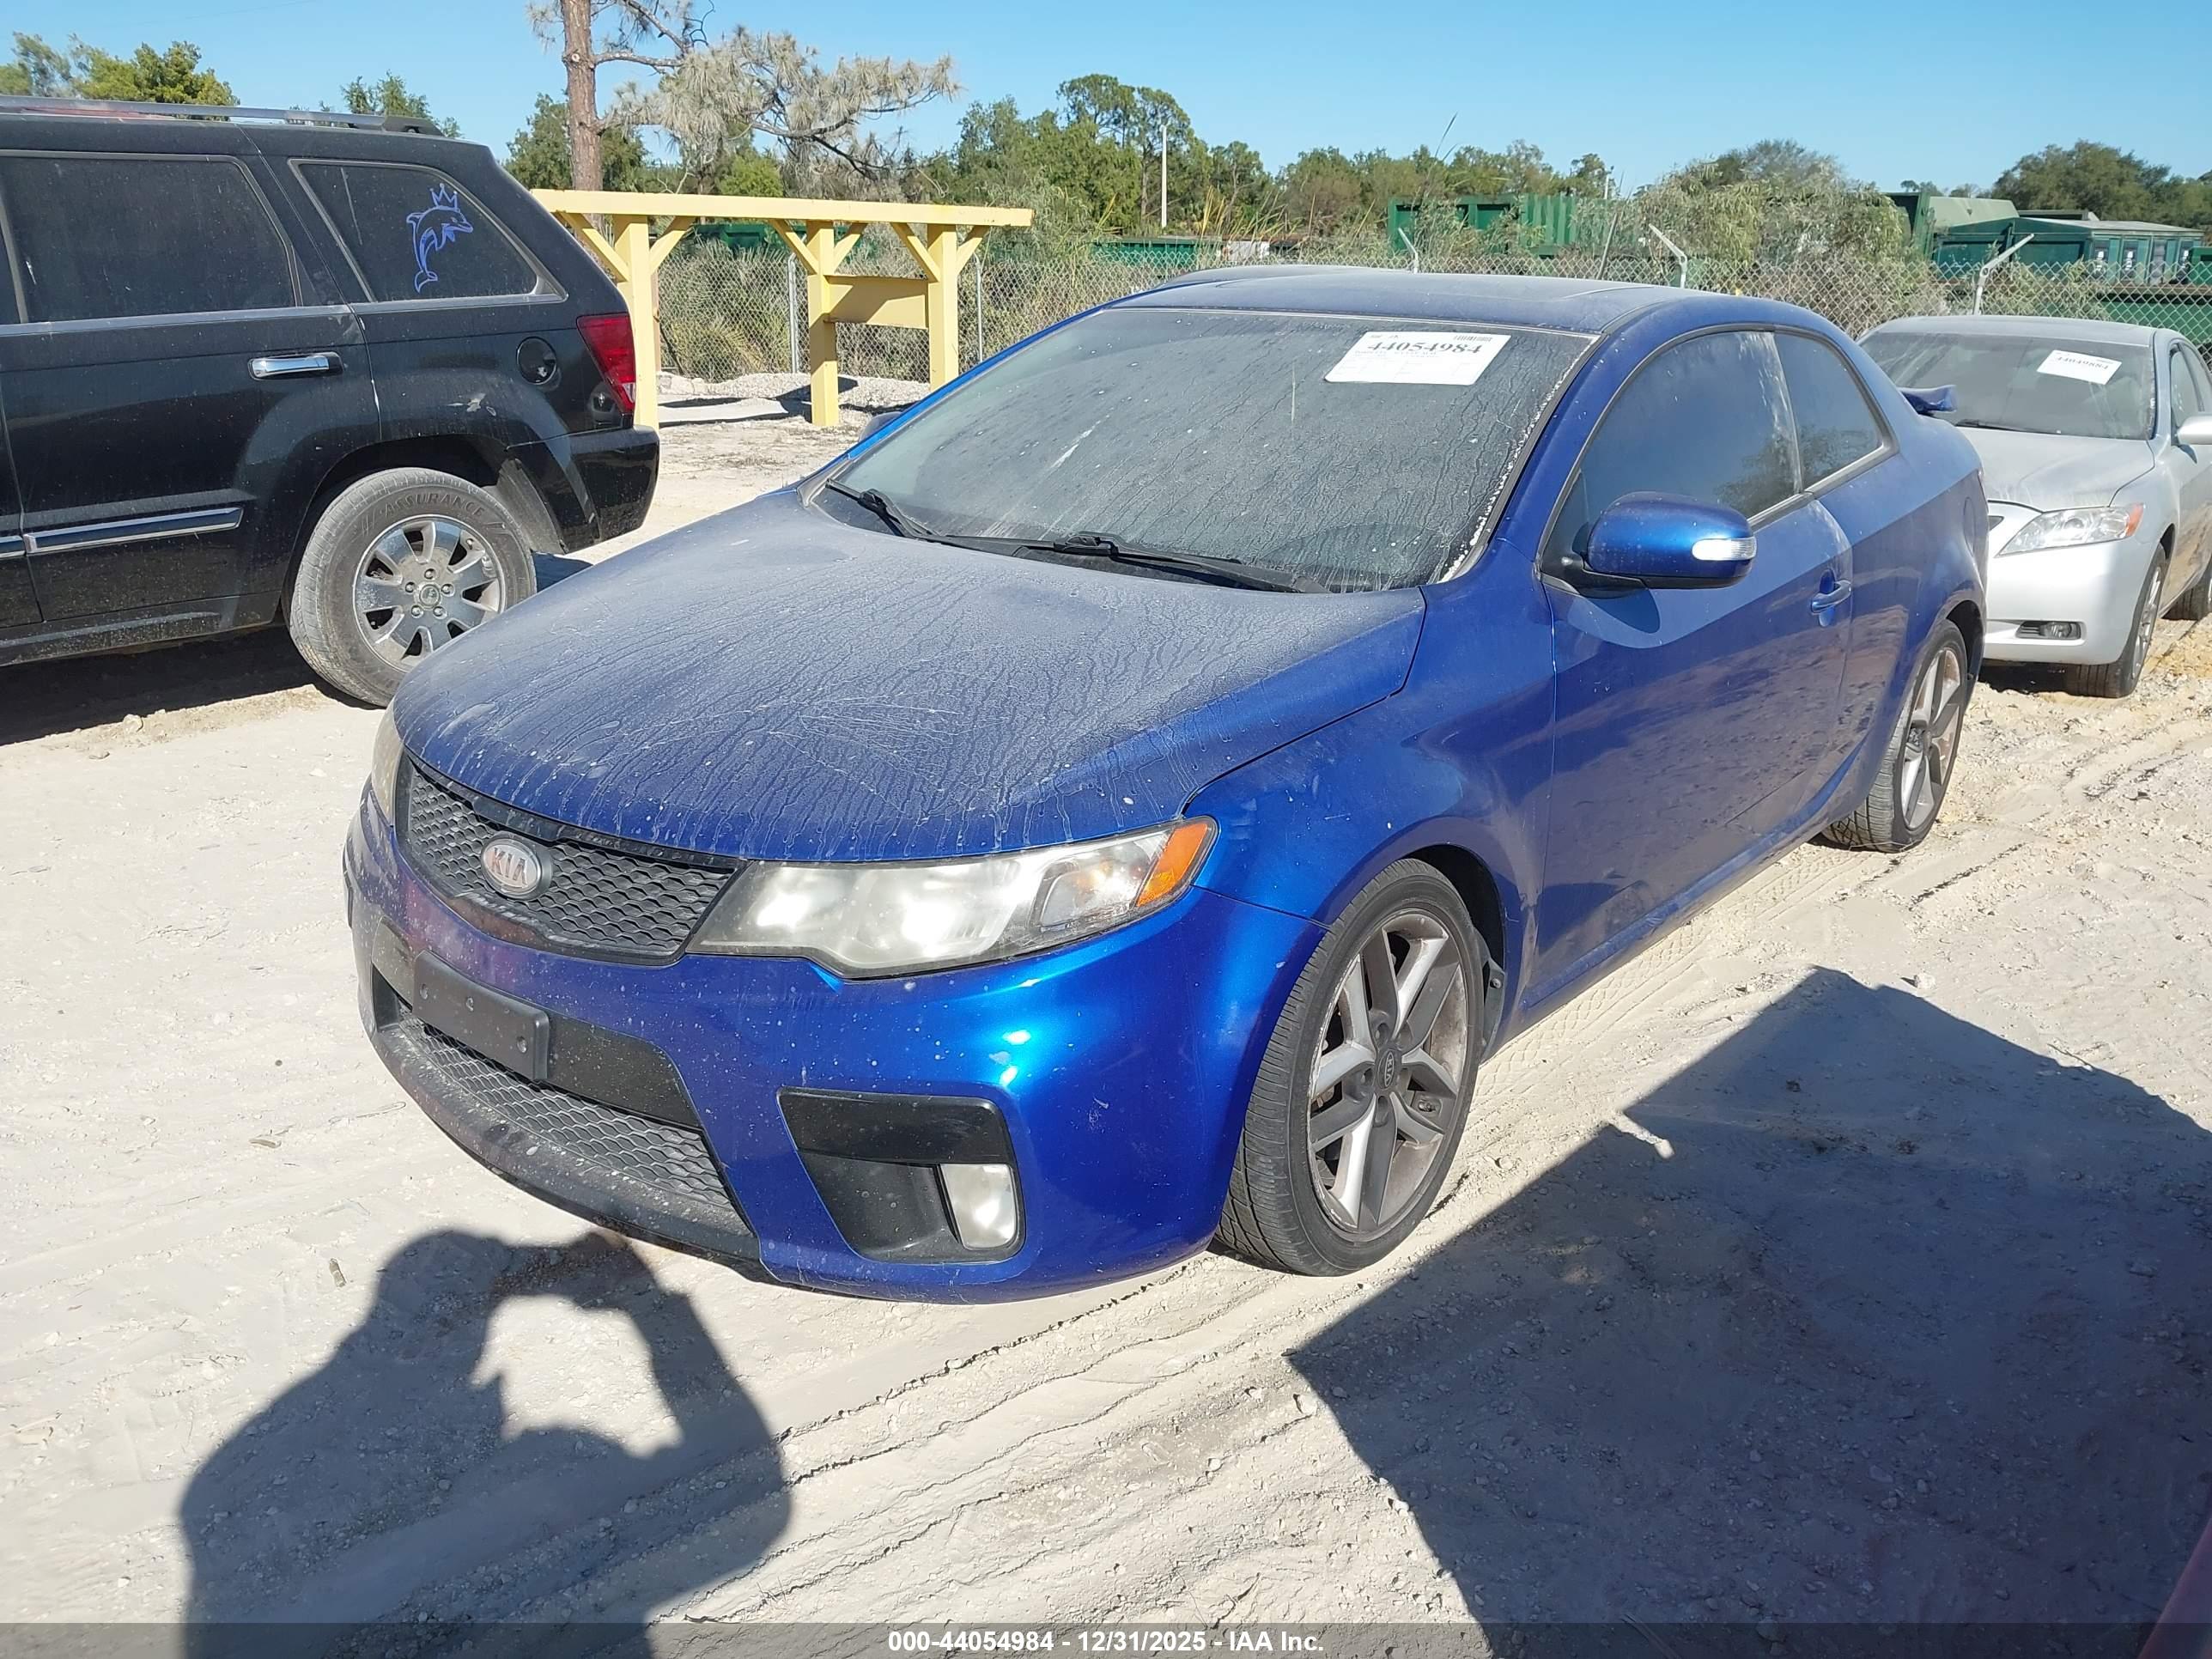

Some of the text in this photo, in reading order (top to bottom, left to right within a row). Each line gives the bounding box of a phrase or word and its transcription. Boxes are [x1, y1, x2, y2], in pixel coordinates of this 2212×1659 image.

[1367, 342, 1483, 355] 44054984
[385, 493, 486, 516] ASSURANCE
[490, 847, 528, 885] KIA
